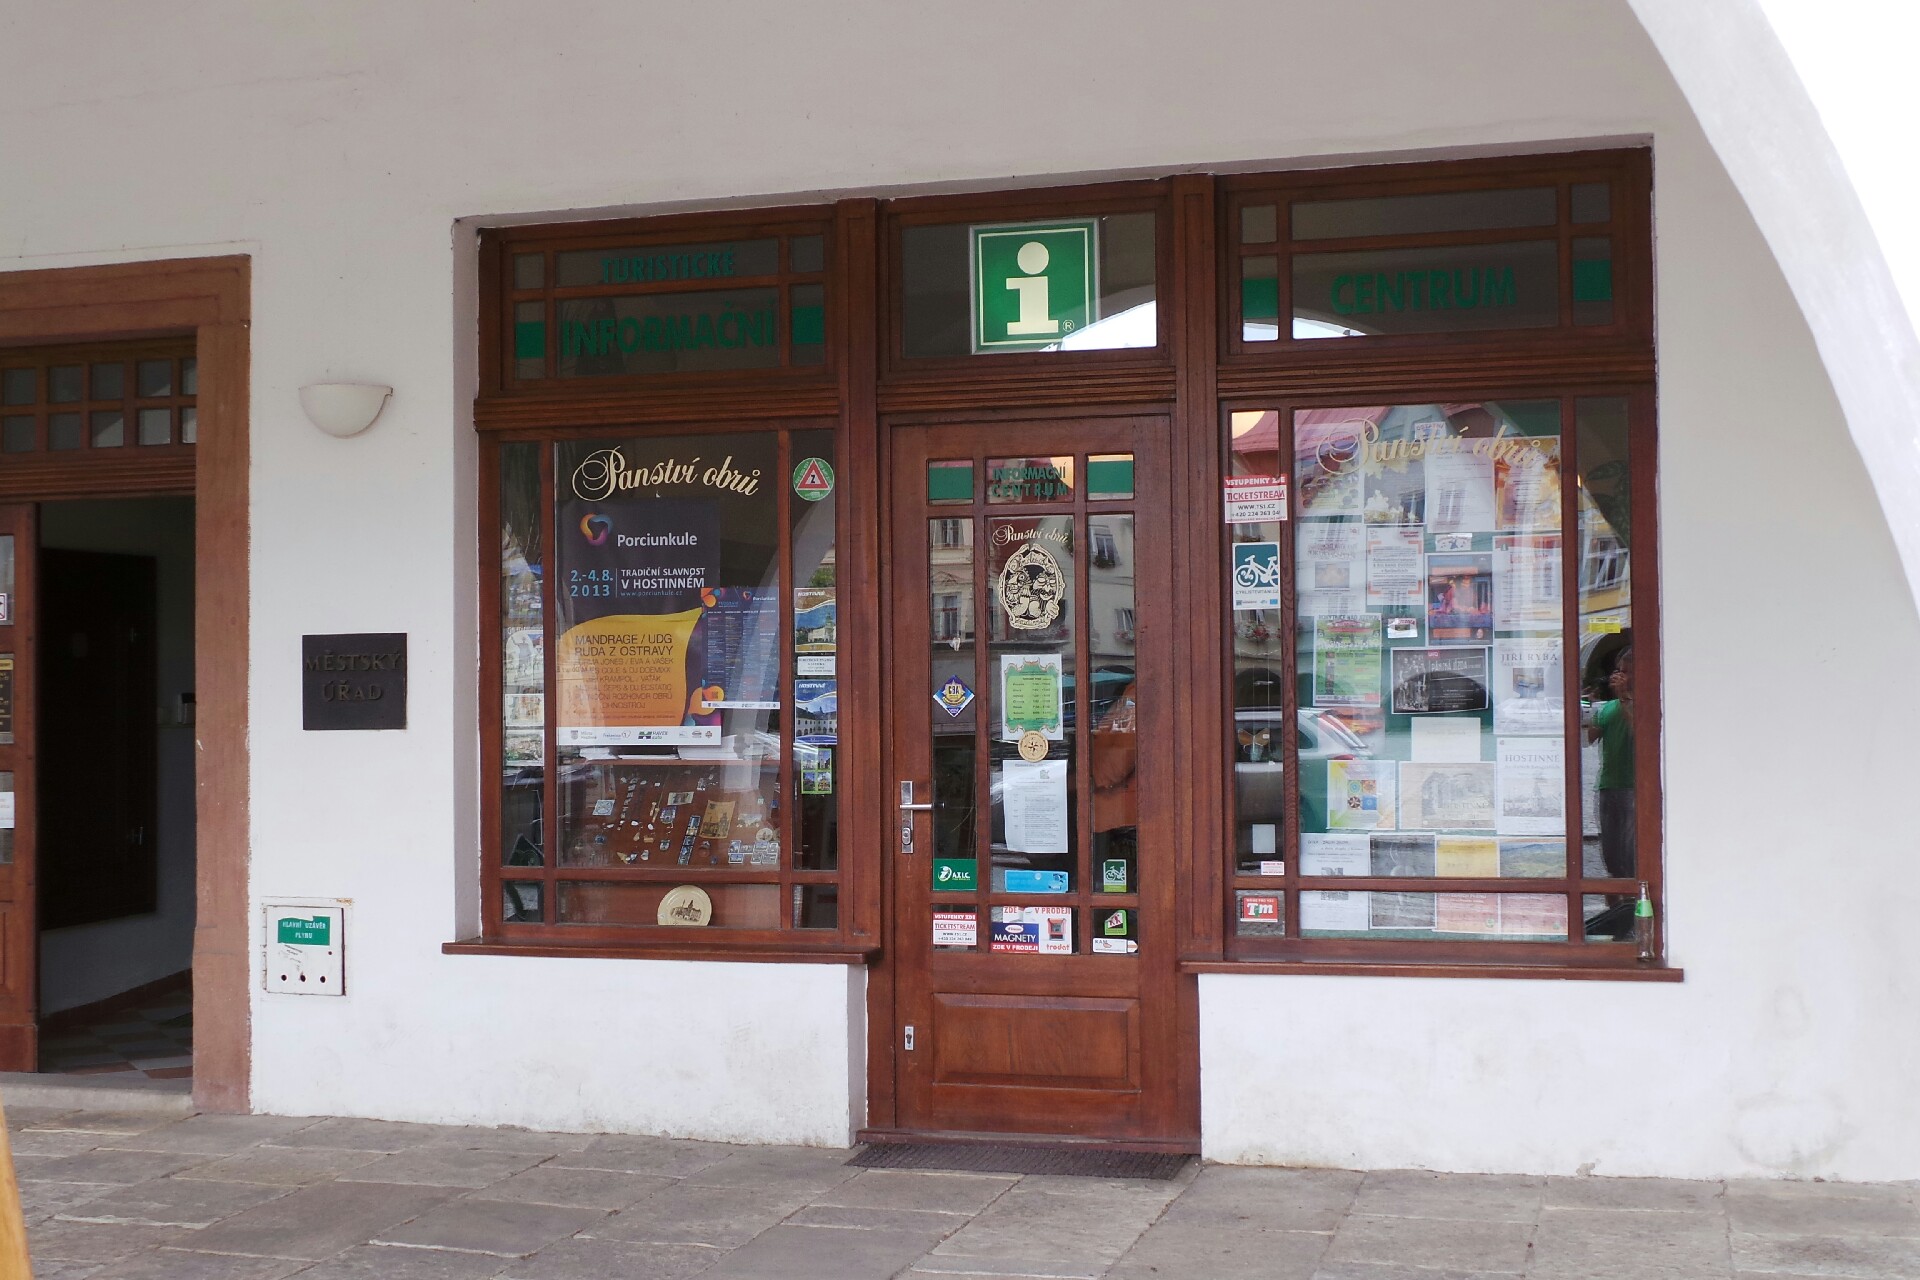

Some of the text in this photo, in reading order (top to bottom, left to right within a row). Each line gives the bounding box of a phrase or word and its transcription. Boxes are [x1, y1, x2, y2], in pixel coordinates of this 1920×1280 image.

[600, 245, 736, 284] TURISTICKÉ
[1330, 265, 1518, 316] CENTRUM
[561, 299, 776, 356] INFORMAČNÍ
[1316, 414, 1469, 475] Panství
[572, 445, 700, 501] Panství
[702, 455, 761, 496] obrů
[992, 461, 1067, 481] INFORMAČNÍ
[1225, 476, 1270, 486] VSTUPENKY
[991, 482, 1068, 498] CENTRUM
[617, 532, 698, 548] Porciunkule
[992, 523, 1069, 547] Panství obrů
[620, 566, 661, 577] TRADIČNÍ
[662, 567, 706, 577] SLAVNOST
[620, 575, 705, 589] V HOSTINNÉM
[570, 584, 611, 598] 2013
[575, 634, 638, 645] MANDRAGE
[648, 633, 673, 644] UDG
[574, 645, 674, 657] RUDA Z OSTRAVY
[305, 650, 401, 671] MĚSTSKÝ
[322, 680, 384, 702] ÚŘAD
[1504, 753, 1560, 763] HOSTINNÉ
[1003, 906, 1018, 914] ZDE
[282, 920, 326, 930] HLAVNÍ UZÁVĚR
[934, 922, 976, 930] TICKETSTREAM
[994, 933, 1037, 943] MAGNETY
[1046, 943, 1070, 951] trodat
